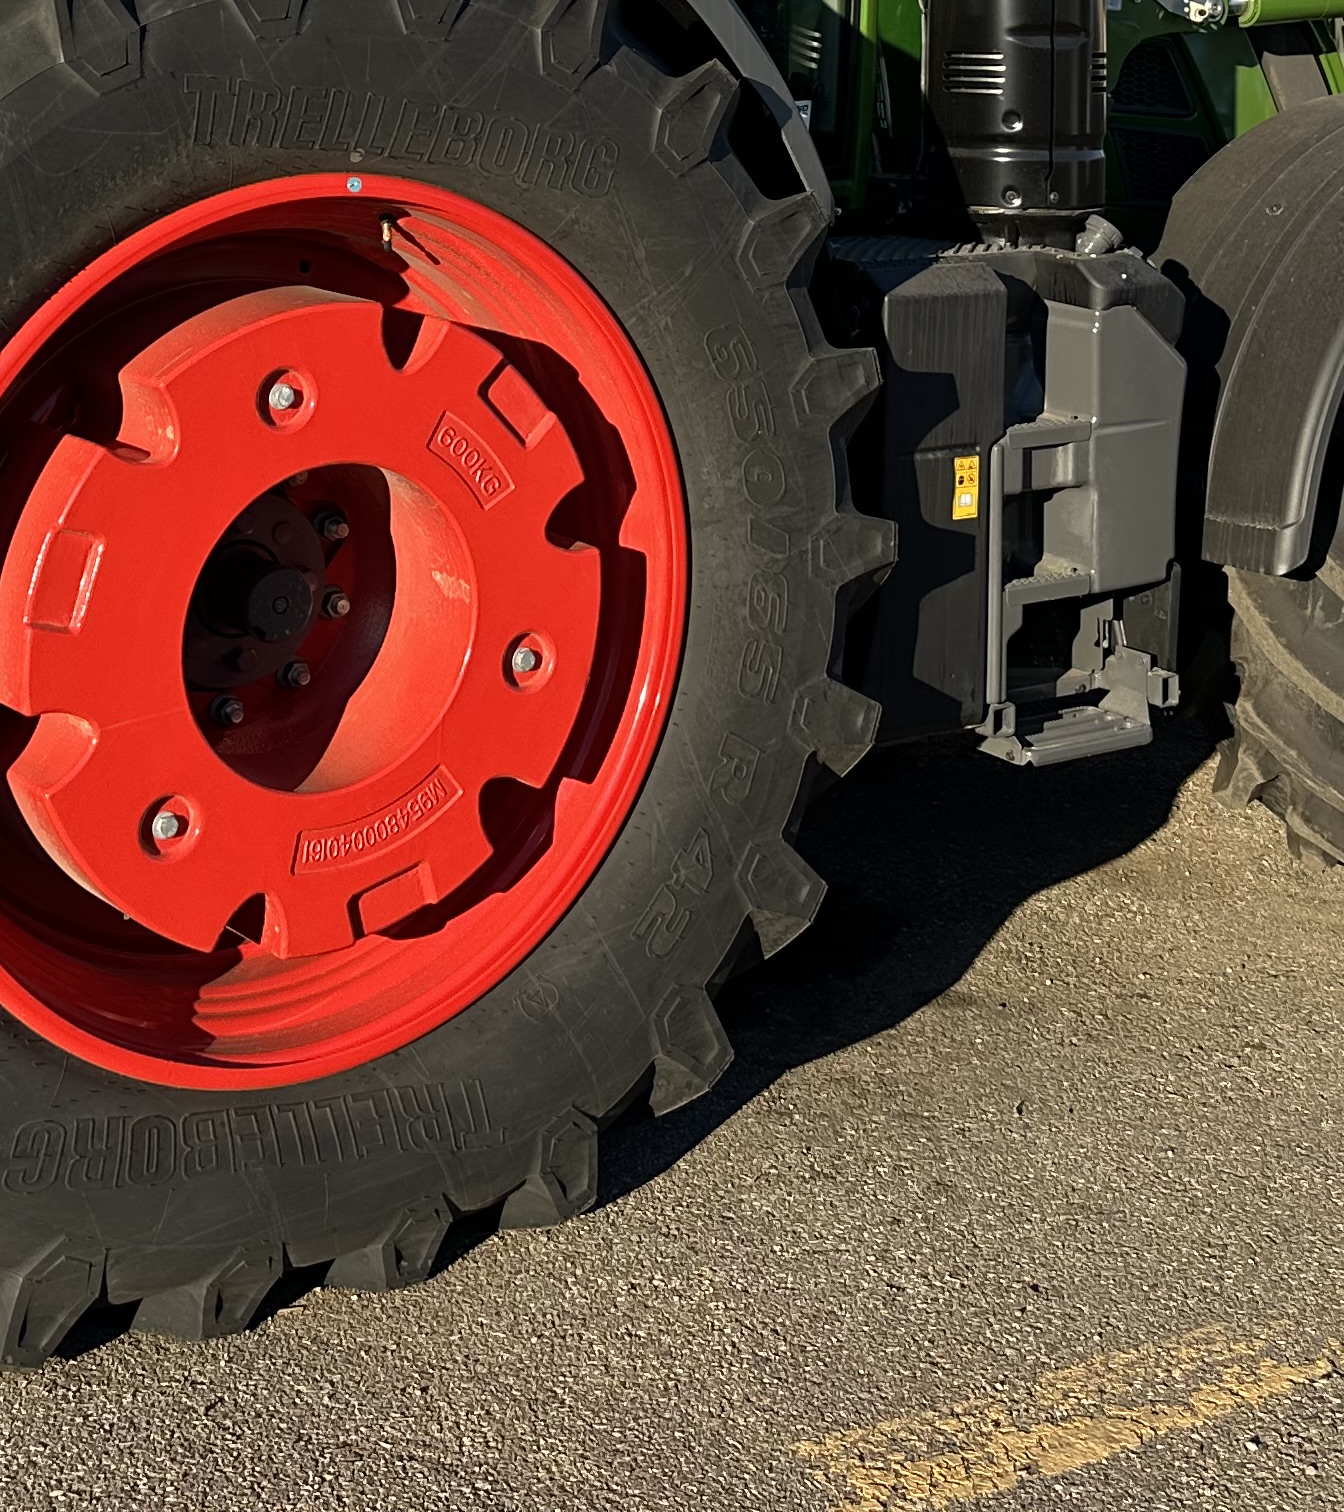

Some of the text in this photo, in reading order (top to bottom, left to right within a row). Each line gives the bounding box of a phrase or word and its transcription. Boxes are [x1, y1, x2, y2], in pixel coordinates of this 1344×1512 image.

[183, 72, 621, 200] TRELLEBORG
[437, 425, 502, 497] 600KG
[709, 732, 763, 804] R
[1, 1079, 506, 1195] TRELLEBORG
